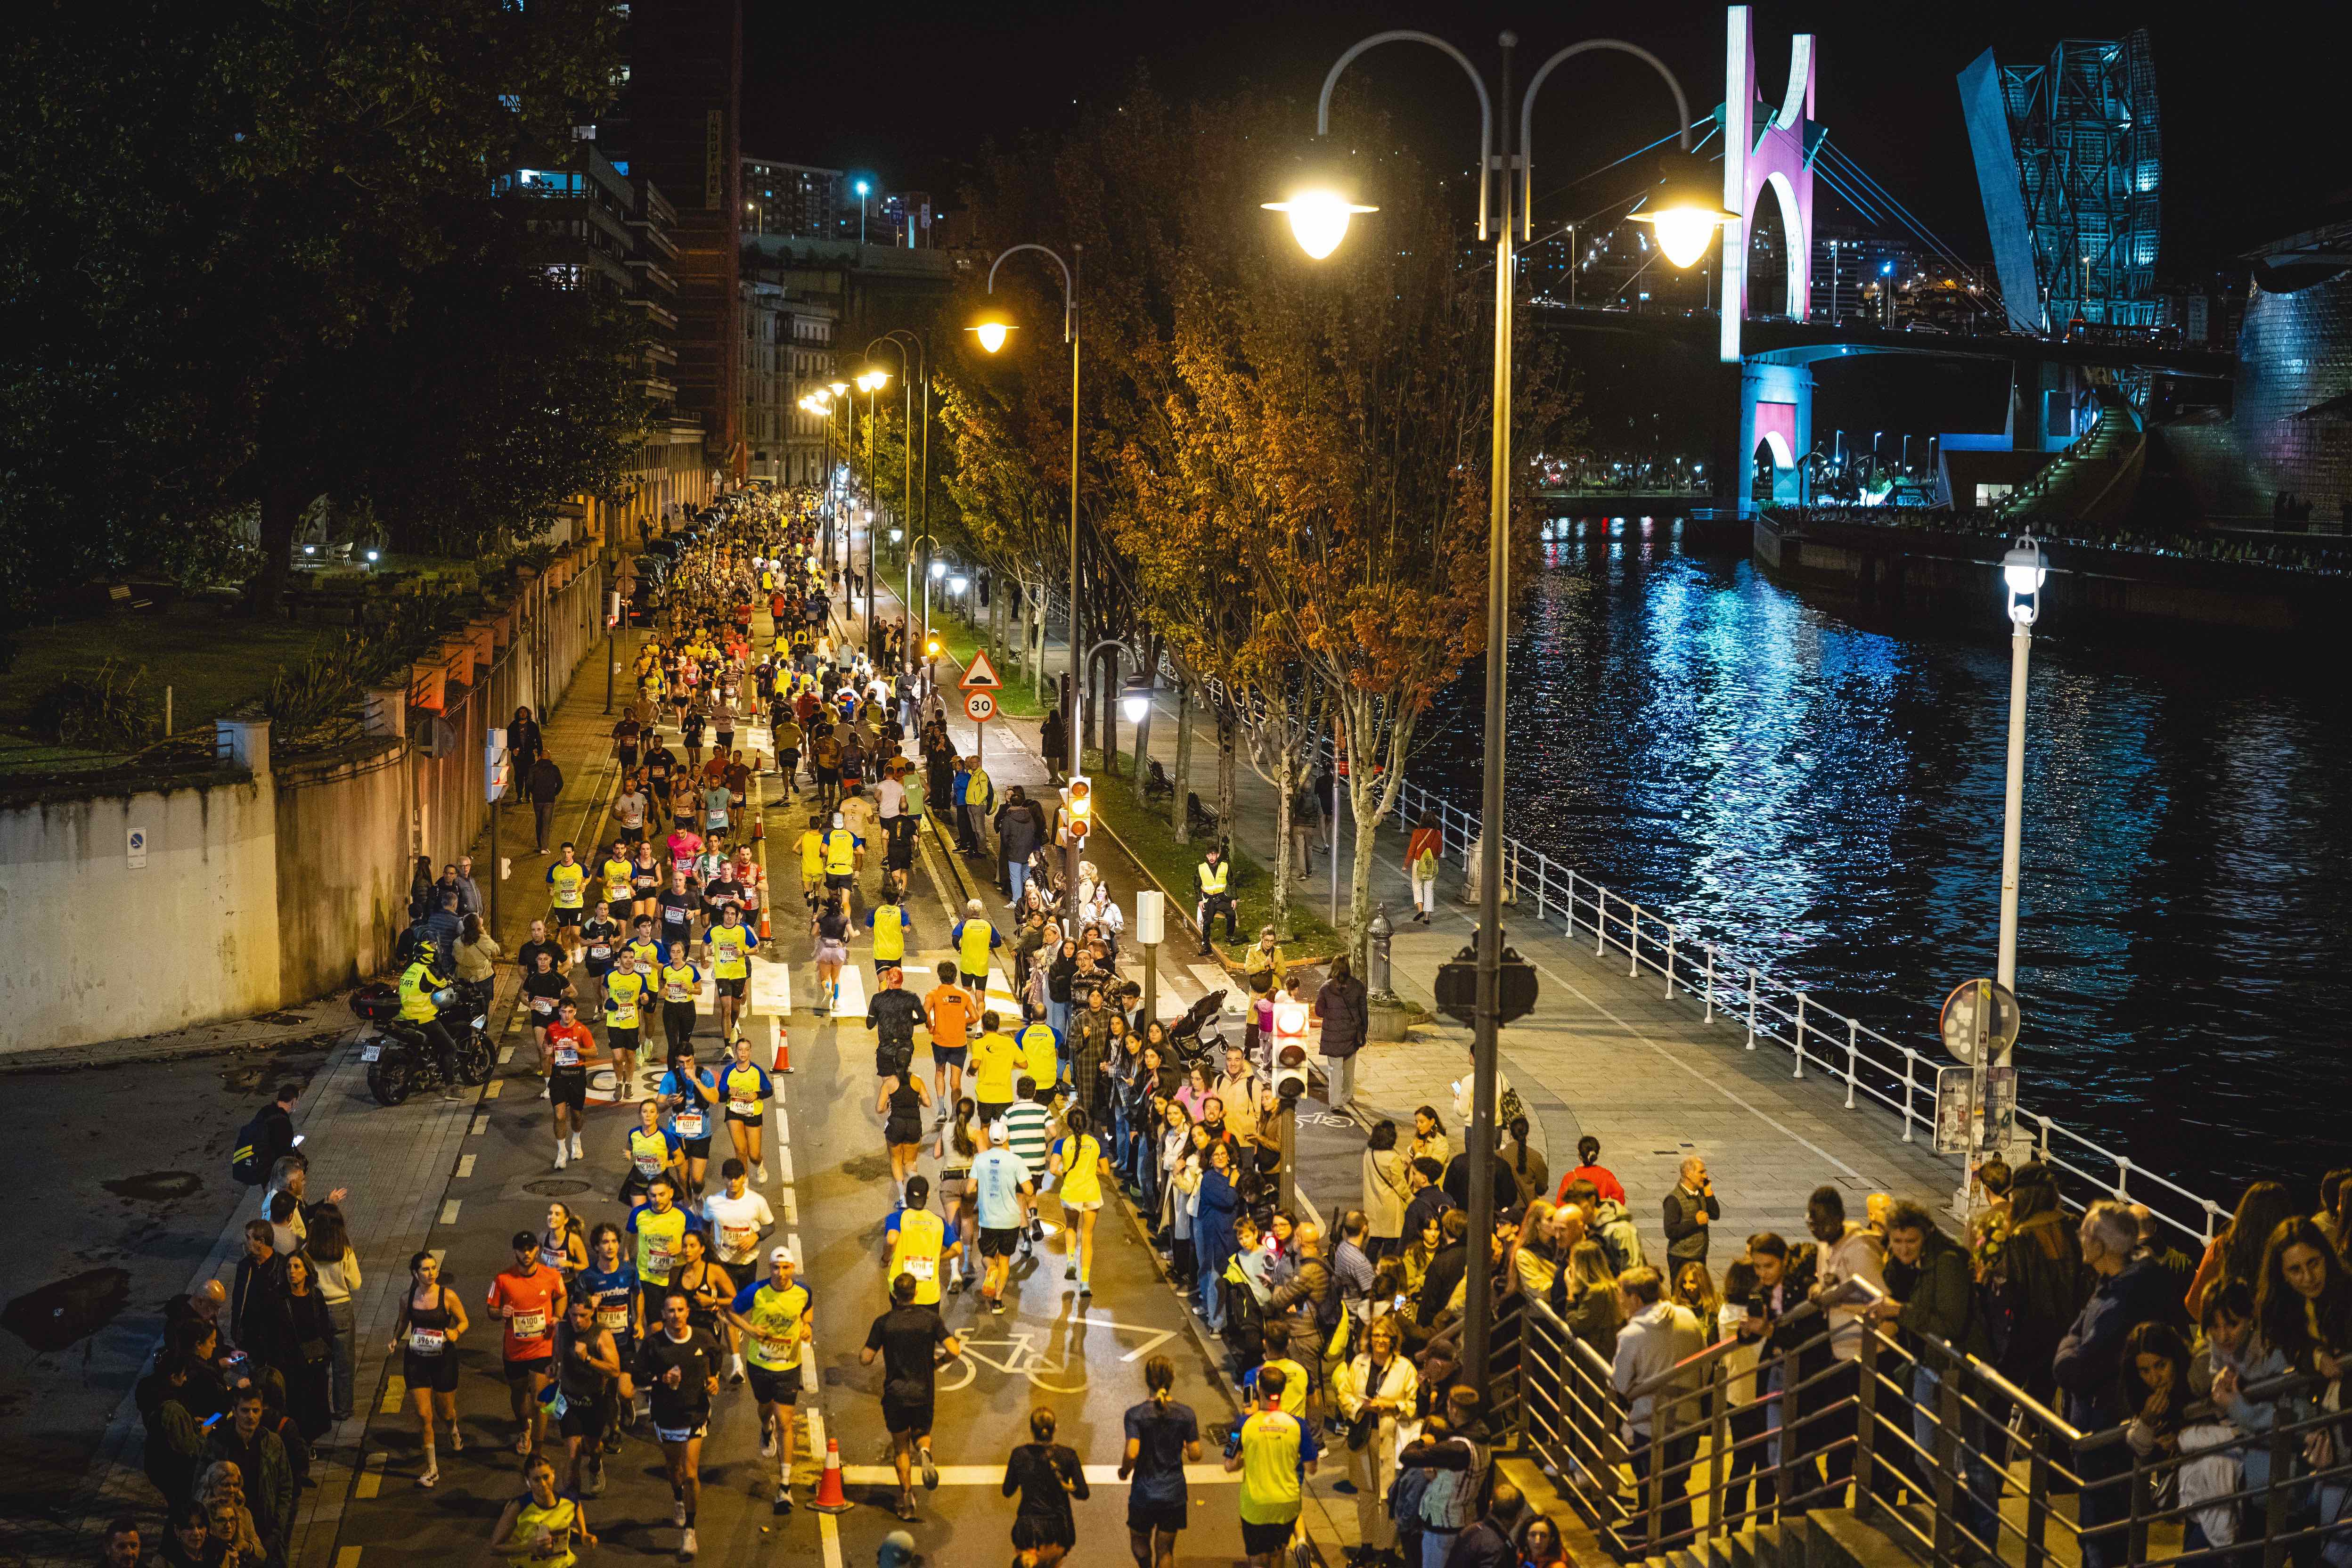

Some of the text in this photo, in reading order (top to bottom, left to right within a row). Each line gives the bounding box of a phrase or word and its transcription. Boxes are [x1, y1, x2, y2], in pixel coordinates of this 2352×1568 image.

[971, 700, 990, 711] 30
[400, 979, 414, 988] STAFF
[521, 1316, 538, 1324] 4100
[416, 1336, 434, 1345] 3964
